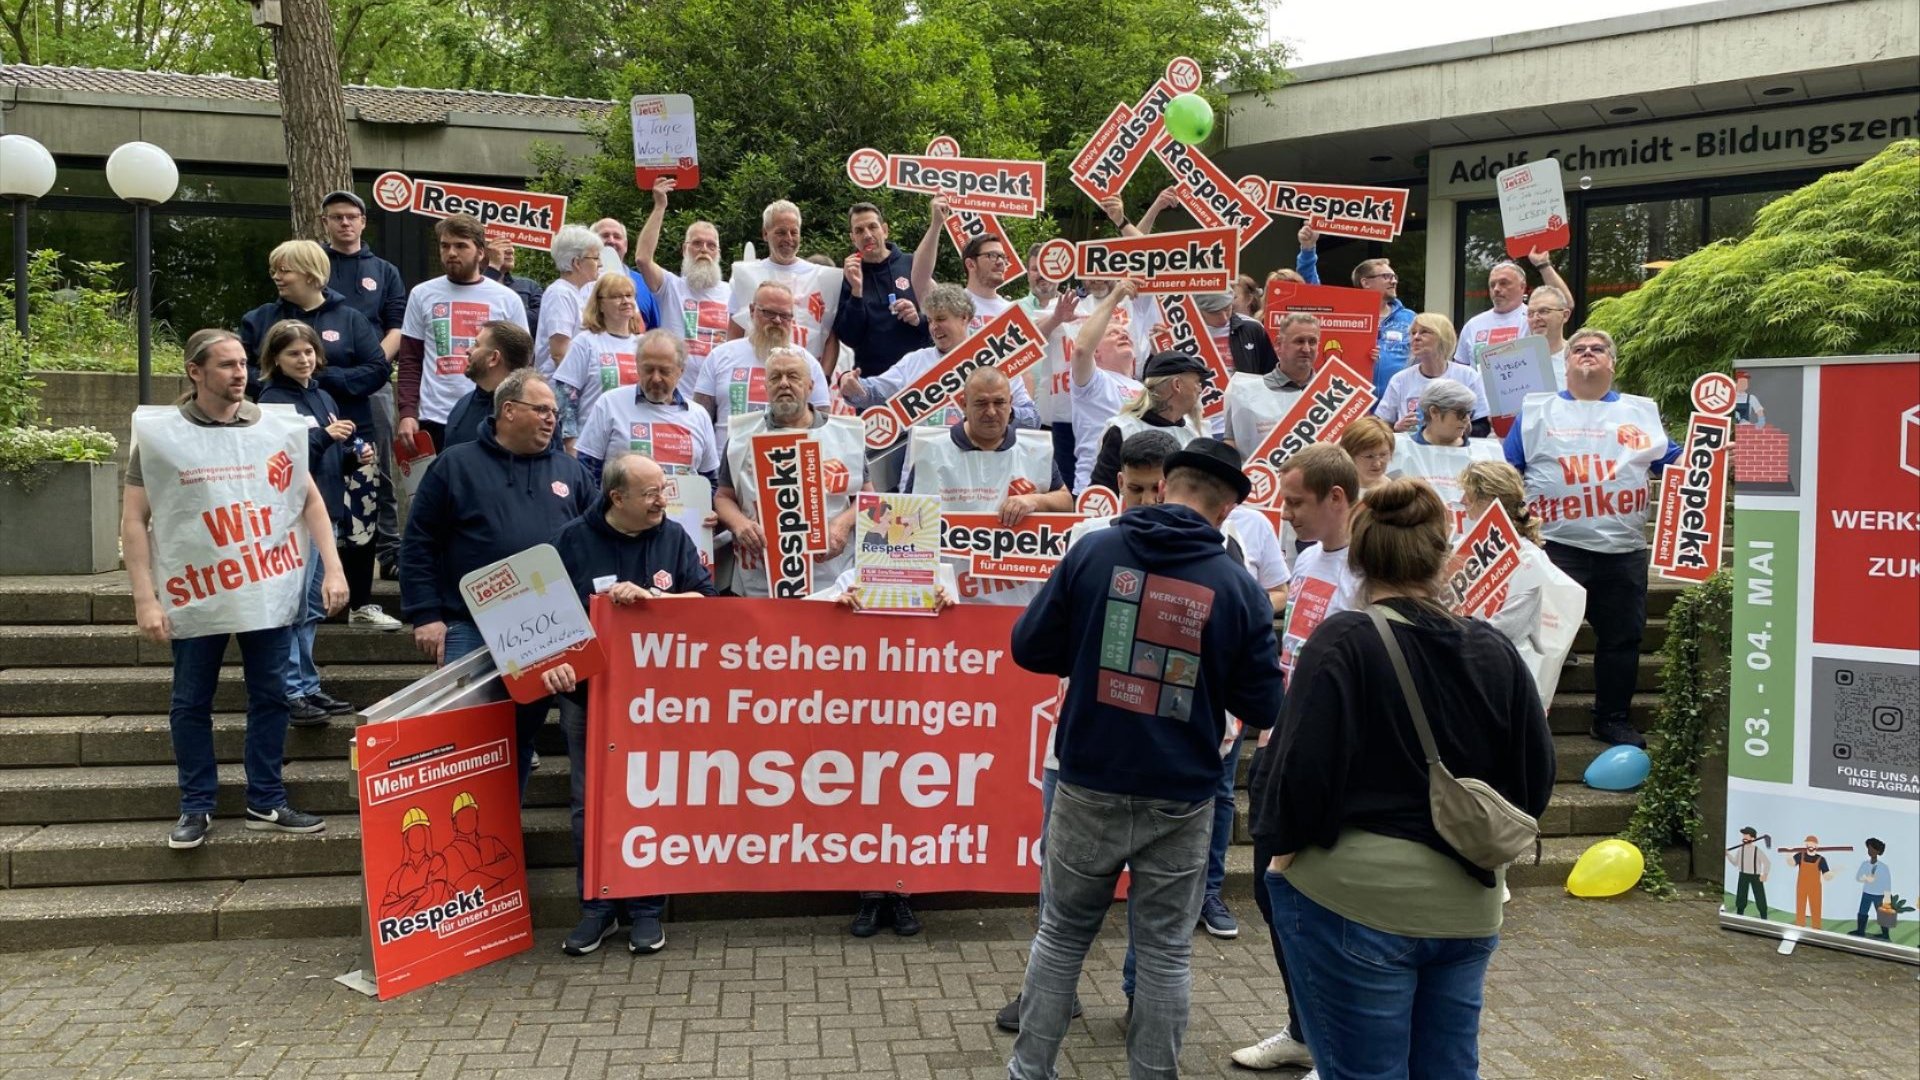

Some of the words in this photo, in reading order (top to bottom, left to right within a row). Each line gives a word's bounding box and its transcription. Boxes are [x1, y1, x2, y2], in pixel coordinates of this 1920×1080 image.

[650, 119, 682, 136] Tage
[898, 160, 1032, 197] Respekt
[1161, 140, 1253, 228] Respekt
[421, 186, 551, 230] Respekt
[965, 199, 997, 210] unsere
[999, 201, 1029, 212] Arbeit
[1275, 187, 1393, 222] Respekt
[517, 232, 546, 244] Arbeit
[1329, 222, 1359, 232] unsere
[1360, 225, 1387, 236] Arbeit
[1086, 242, 1225, 278] Respekt
[1152, 279, 1186, 289] unsere
[1189, 277, 1221, 288] Arbeit
[1007, 350, 1036, 374] Arbeit
[805, 449, 816, 483] Arbeit
[1558, 454, 1617, 485] Wir
[808, 487, 820, 524] unsere
[1677, 425, 1724, 568] Respekt
[202, 501, 272, 547] Wir
[768, 447, 809, 598] Respekt
[862, 542, 916, 555] Respect
[1660, 528, 1672, 560] Arbeit
[166, 531, 304, 607] streiken!
[998, 562, 1037, 573] unsere
[1747, 541, 1774, 605] MAI
[478, 574, 516, 602] Jetzt!
[1149, 591, 1209, 613] WERKSTATT
[1187, 608, 1206, 621] DER
[631, 632, 709, 669] Wir
[719, 635, 866, 672] stehen
[878, 637, 1004, 676] hinter
[1746, 621, 1772, 671] 04.
[1127, 682, 1145, 696] BIN
[628, 688, 710, 725] den
[727, 688, 997, 736] Forderungen
[1744, 708, 1770, 757] 03.
[374, 773, 415, 797] Mehr
[419, 745, 503, 785] Einkommen!
[626, 749, 995, 809] unserer
[1837, 765, 1878, 780] FOLGE
[1880, 771, 1908, 783] UNS
[621, 823, 990, 869] Gewerkschaft!
[379, 887, 484, 943] Respekt
[457, 909, 489, 927] unsere
[491, 896, 519, 914] Arbeit
